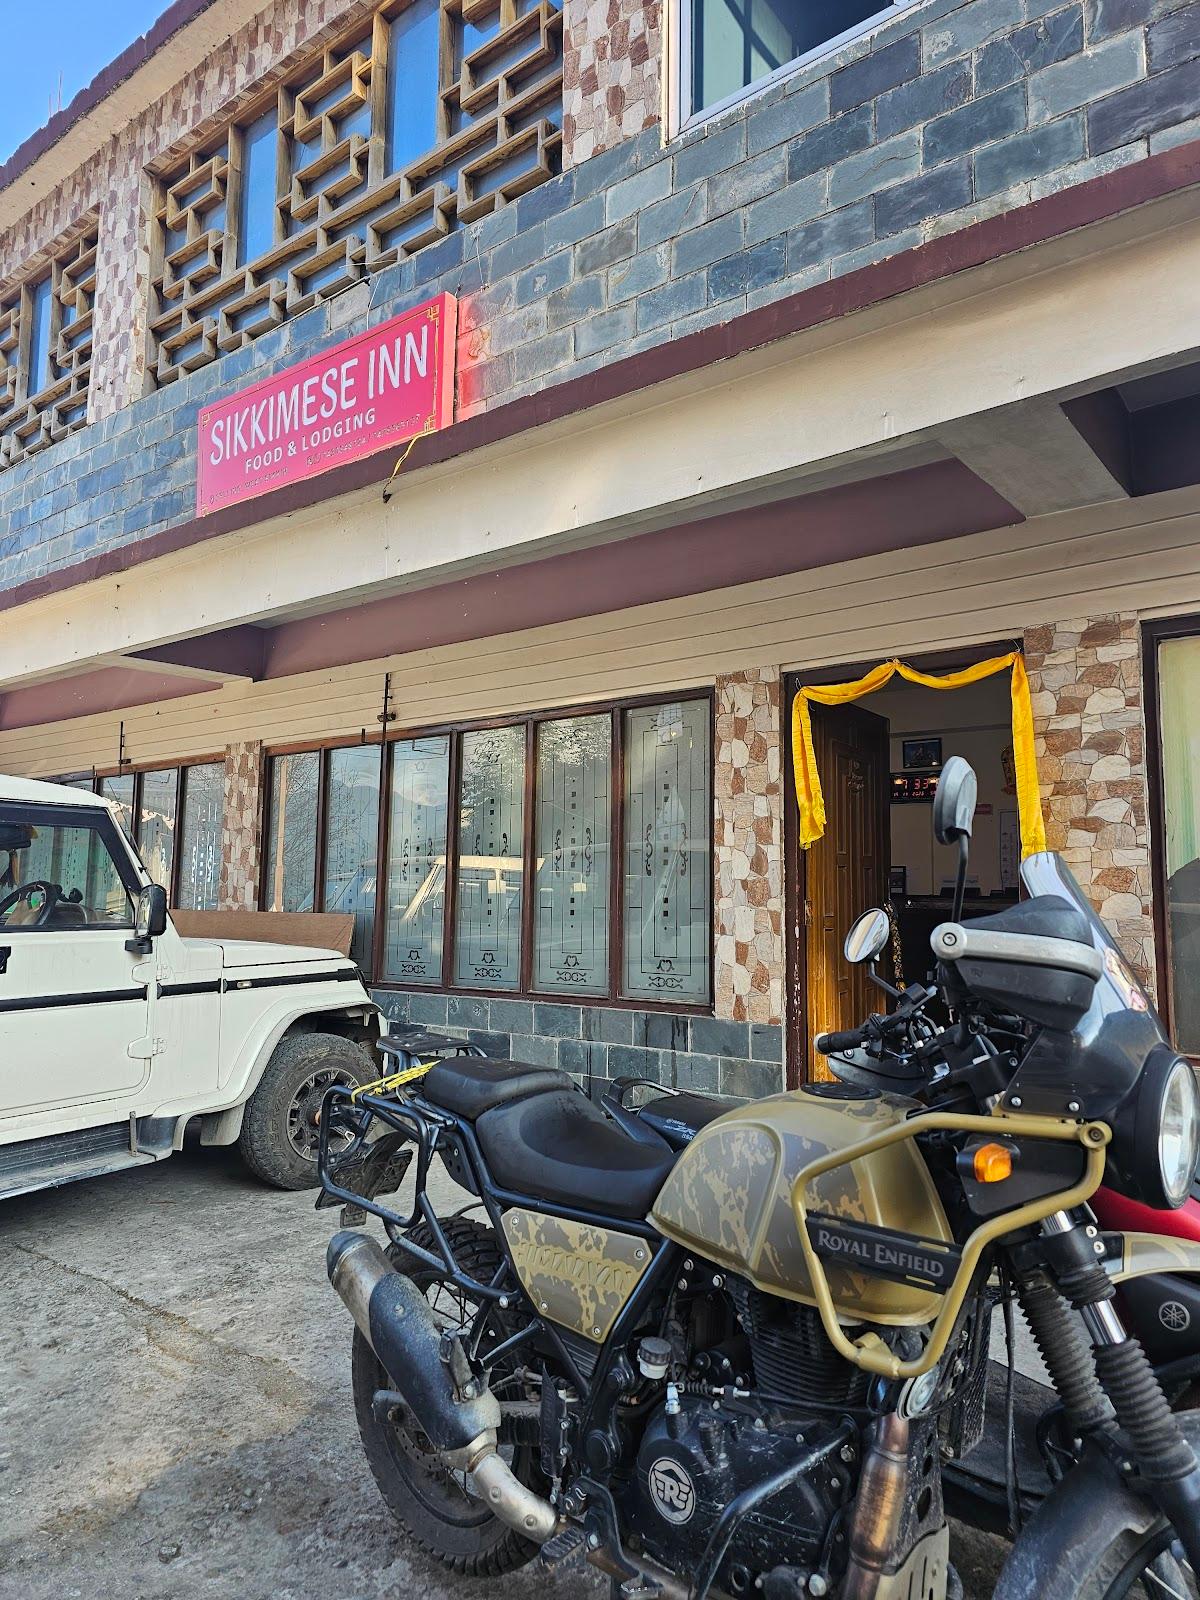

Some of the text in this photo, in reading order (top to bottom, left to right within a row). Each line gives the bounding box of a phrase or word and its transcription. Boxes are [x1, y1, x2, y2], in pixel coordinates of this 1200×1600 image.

[210, 325, 428, 466] SIKKIMESE INN
[245, 447, 283, 474] FOOD
[287, 441, 298, 457] &
[301, 408, 376, 452] LODGING
[818, 1229, 945, 1278] ROYAL ENFIELD
